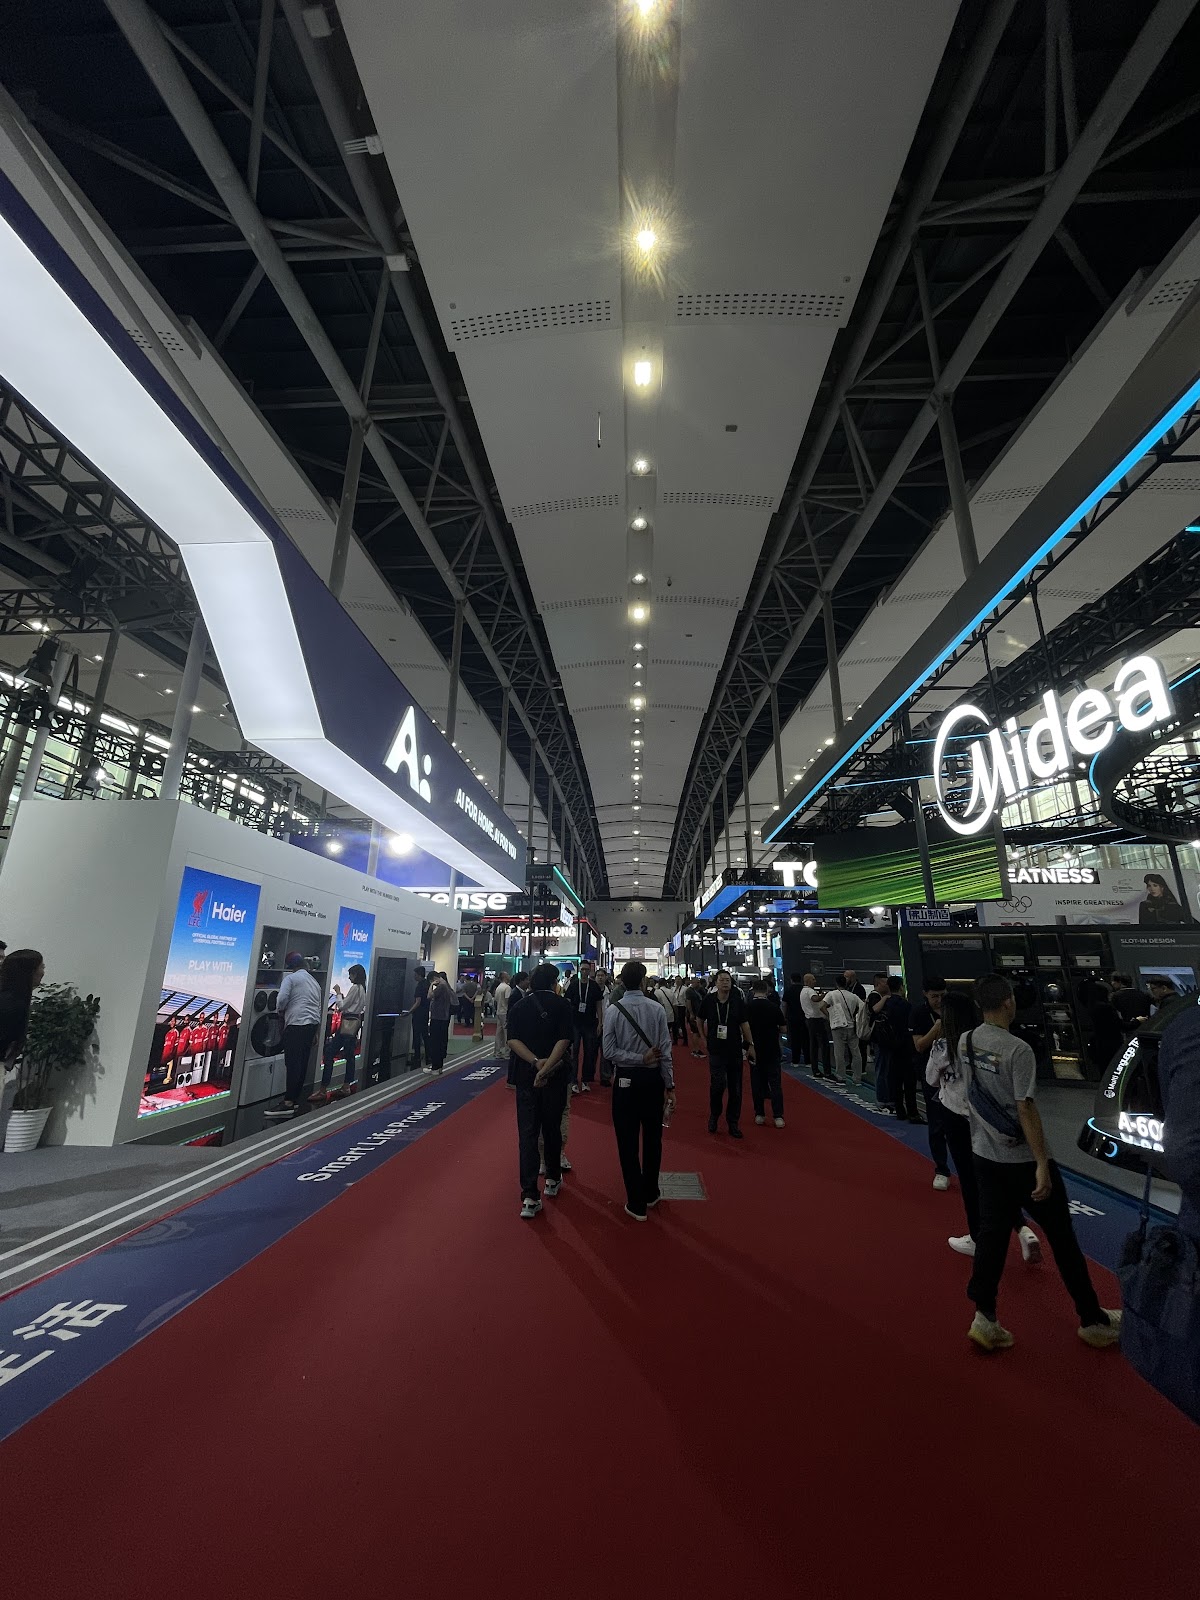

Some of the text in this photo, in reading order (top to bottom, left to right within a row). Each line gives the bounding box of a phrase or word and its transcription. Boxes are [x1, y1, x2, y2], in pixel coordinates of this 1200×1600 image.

[934, 656, 1175, 835] Midea
[455, 788, 465, 810] AI
[465, 796, 478, 823] FOR
[500, 833, 508, 853] FOR
[212, 902, 246, 923] Haier
[352, 929, 368, 942] Haier
[624, 922, 648, 935] 3.2
[188, 960, 232, 971] PLAY WITH
[1119, 1111, 1164, 1141] A-60
[297, 1101, 446, 1182] Smart Life Product
